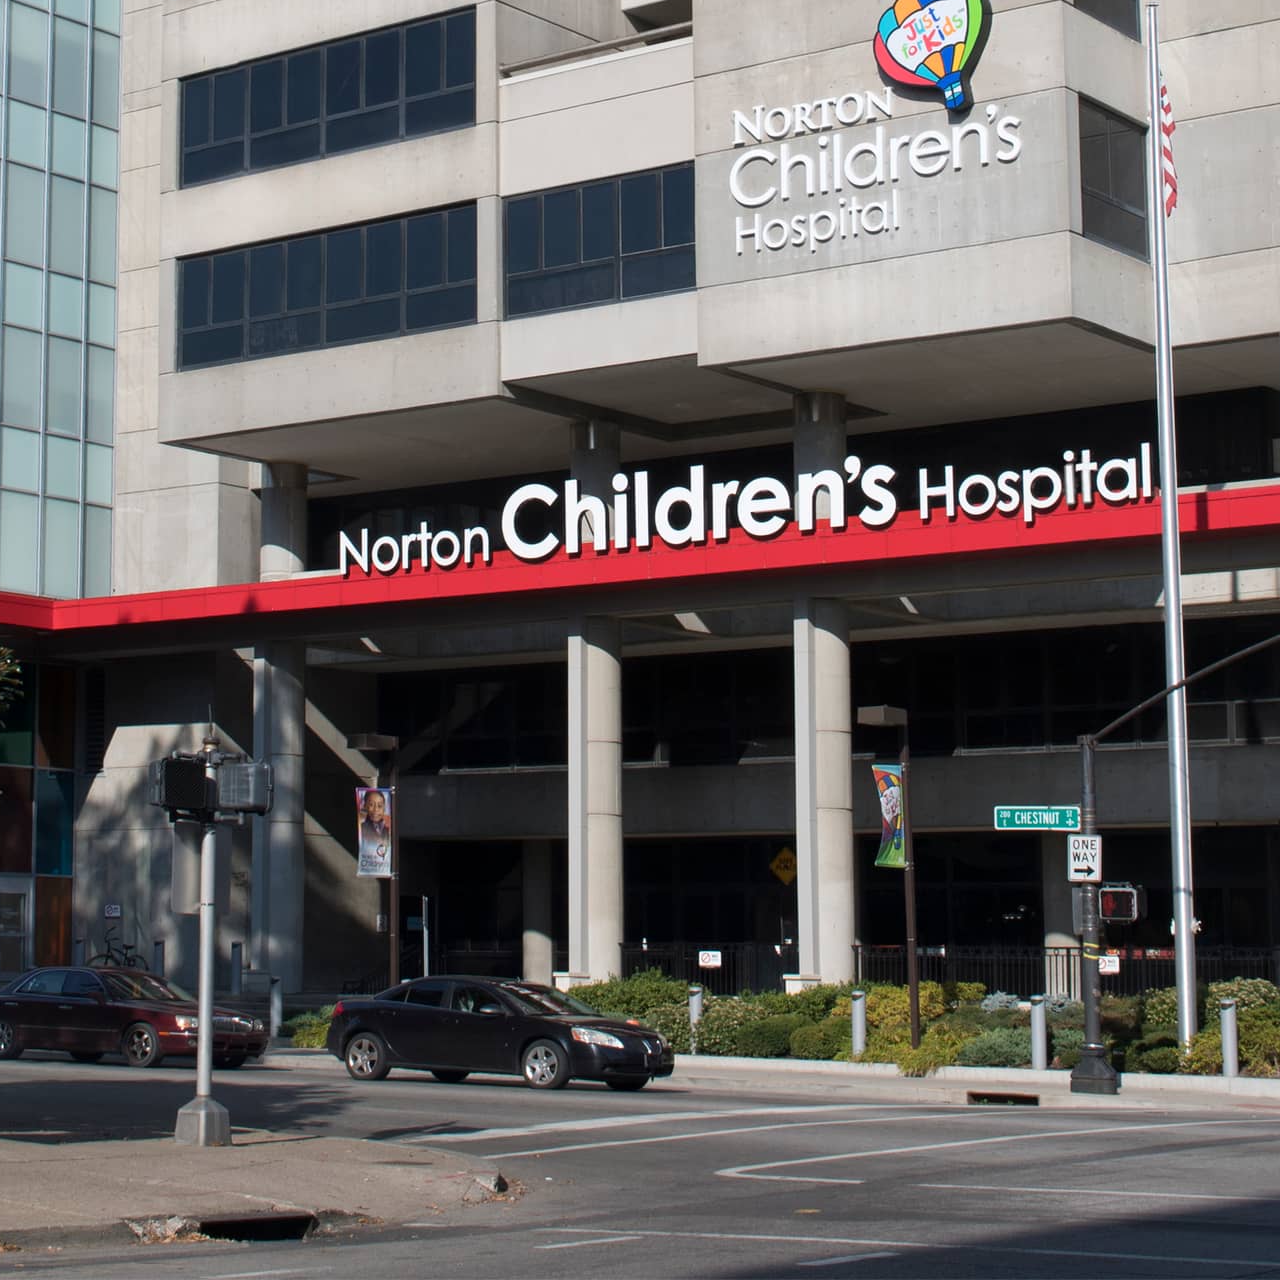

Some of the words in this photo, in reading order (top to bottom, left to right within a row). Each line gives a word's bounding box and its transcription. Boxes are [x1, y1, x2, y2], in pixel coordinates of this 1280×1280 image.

[902, 39, 923, 59] for
[923, 14, 963, 52] Kids
[903, 8, 940, 41] Just
[731, 86, 895, 148] NORTON
[729, 104, 1022, 207] Children's
[735, 188, 901, 255] Hospital
[339, 521, 491, 577] Norton
[501, 455, 898, 561] Children's
[919, 442, 1152, 524] Hospital
[999, 810, 1011, 818] 200
[1014, 811, 1060, 825] CHESTNUT
[1065, 810, 1073, 818] ST
[1072, 839, 1097, 850] ONE
[1072, 851, 1097, 863] WAY
